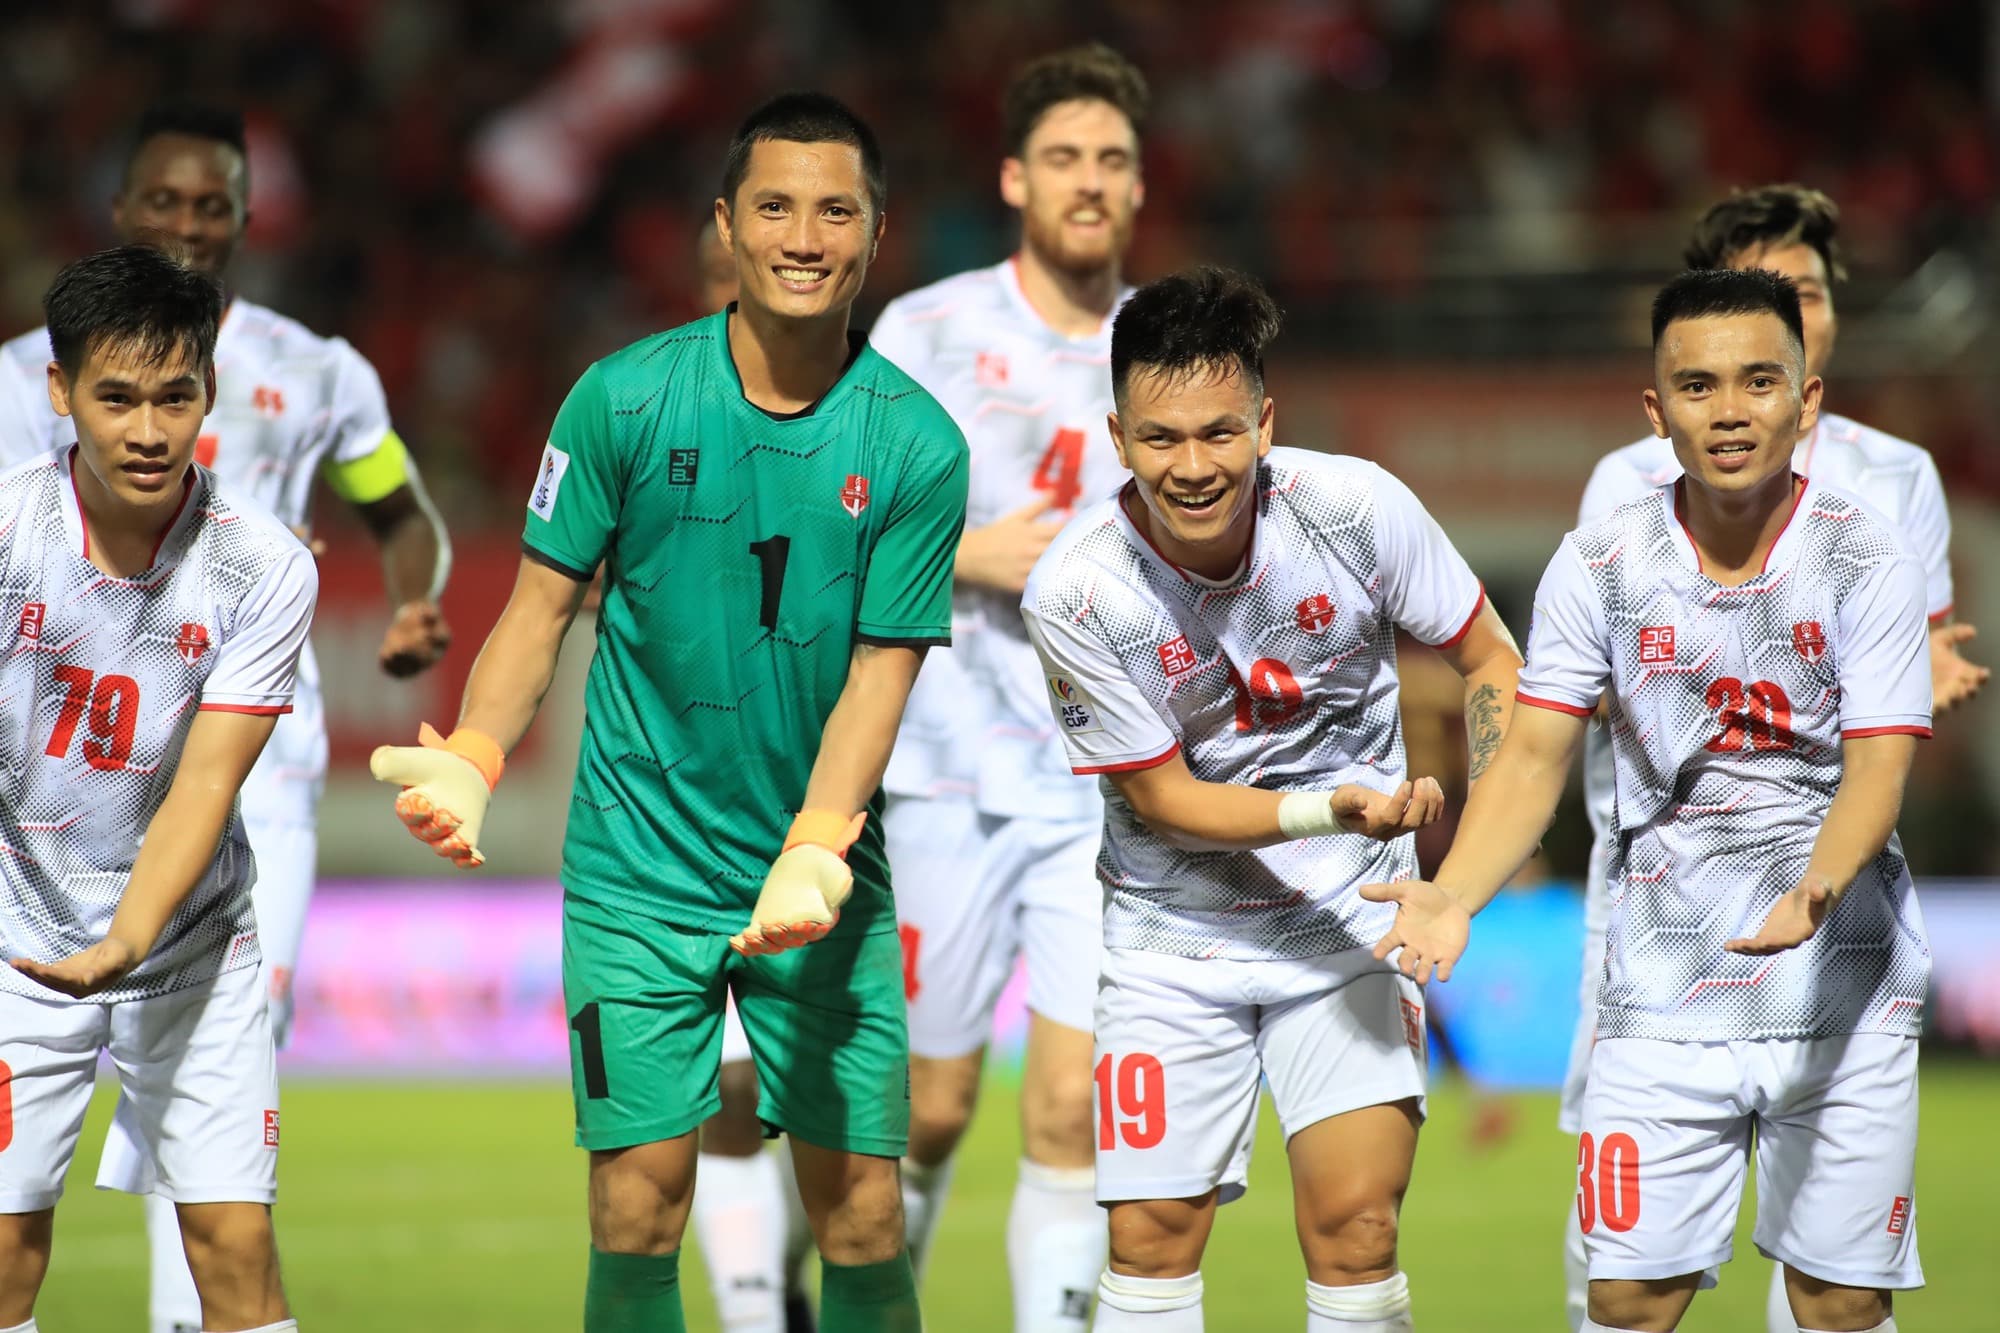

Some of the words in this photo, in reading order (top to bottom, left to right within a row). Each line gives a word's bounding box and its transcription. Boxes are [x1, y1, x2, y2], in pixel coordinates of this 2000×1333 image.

[1032, 427, 1085, 510] 4
[749, 534, 790, 632] 1
[44, 663, 140, 771] 79
[1062, 704, 1085, 717] AFC
[1065, 715, 1089, 727] CUP
[1226, 656, 1304, 731] 19
[571, 1002, 610, 1099] 1
[1094, 1052, 1166, 1150] 19
[1577, 1131, 1640, 1234] 30
